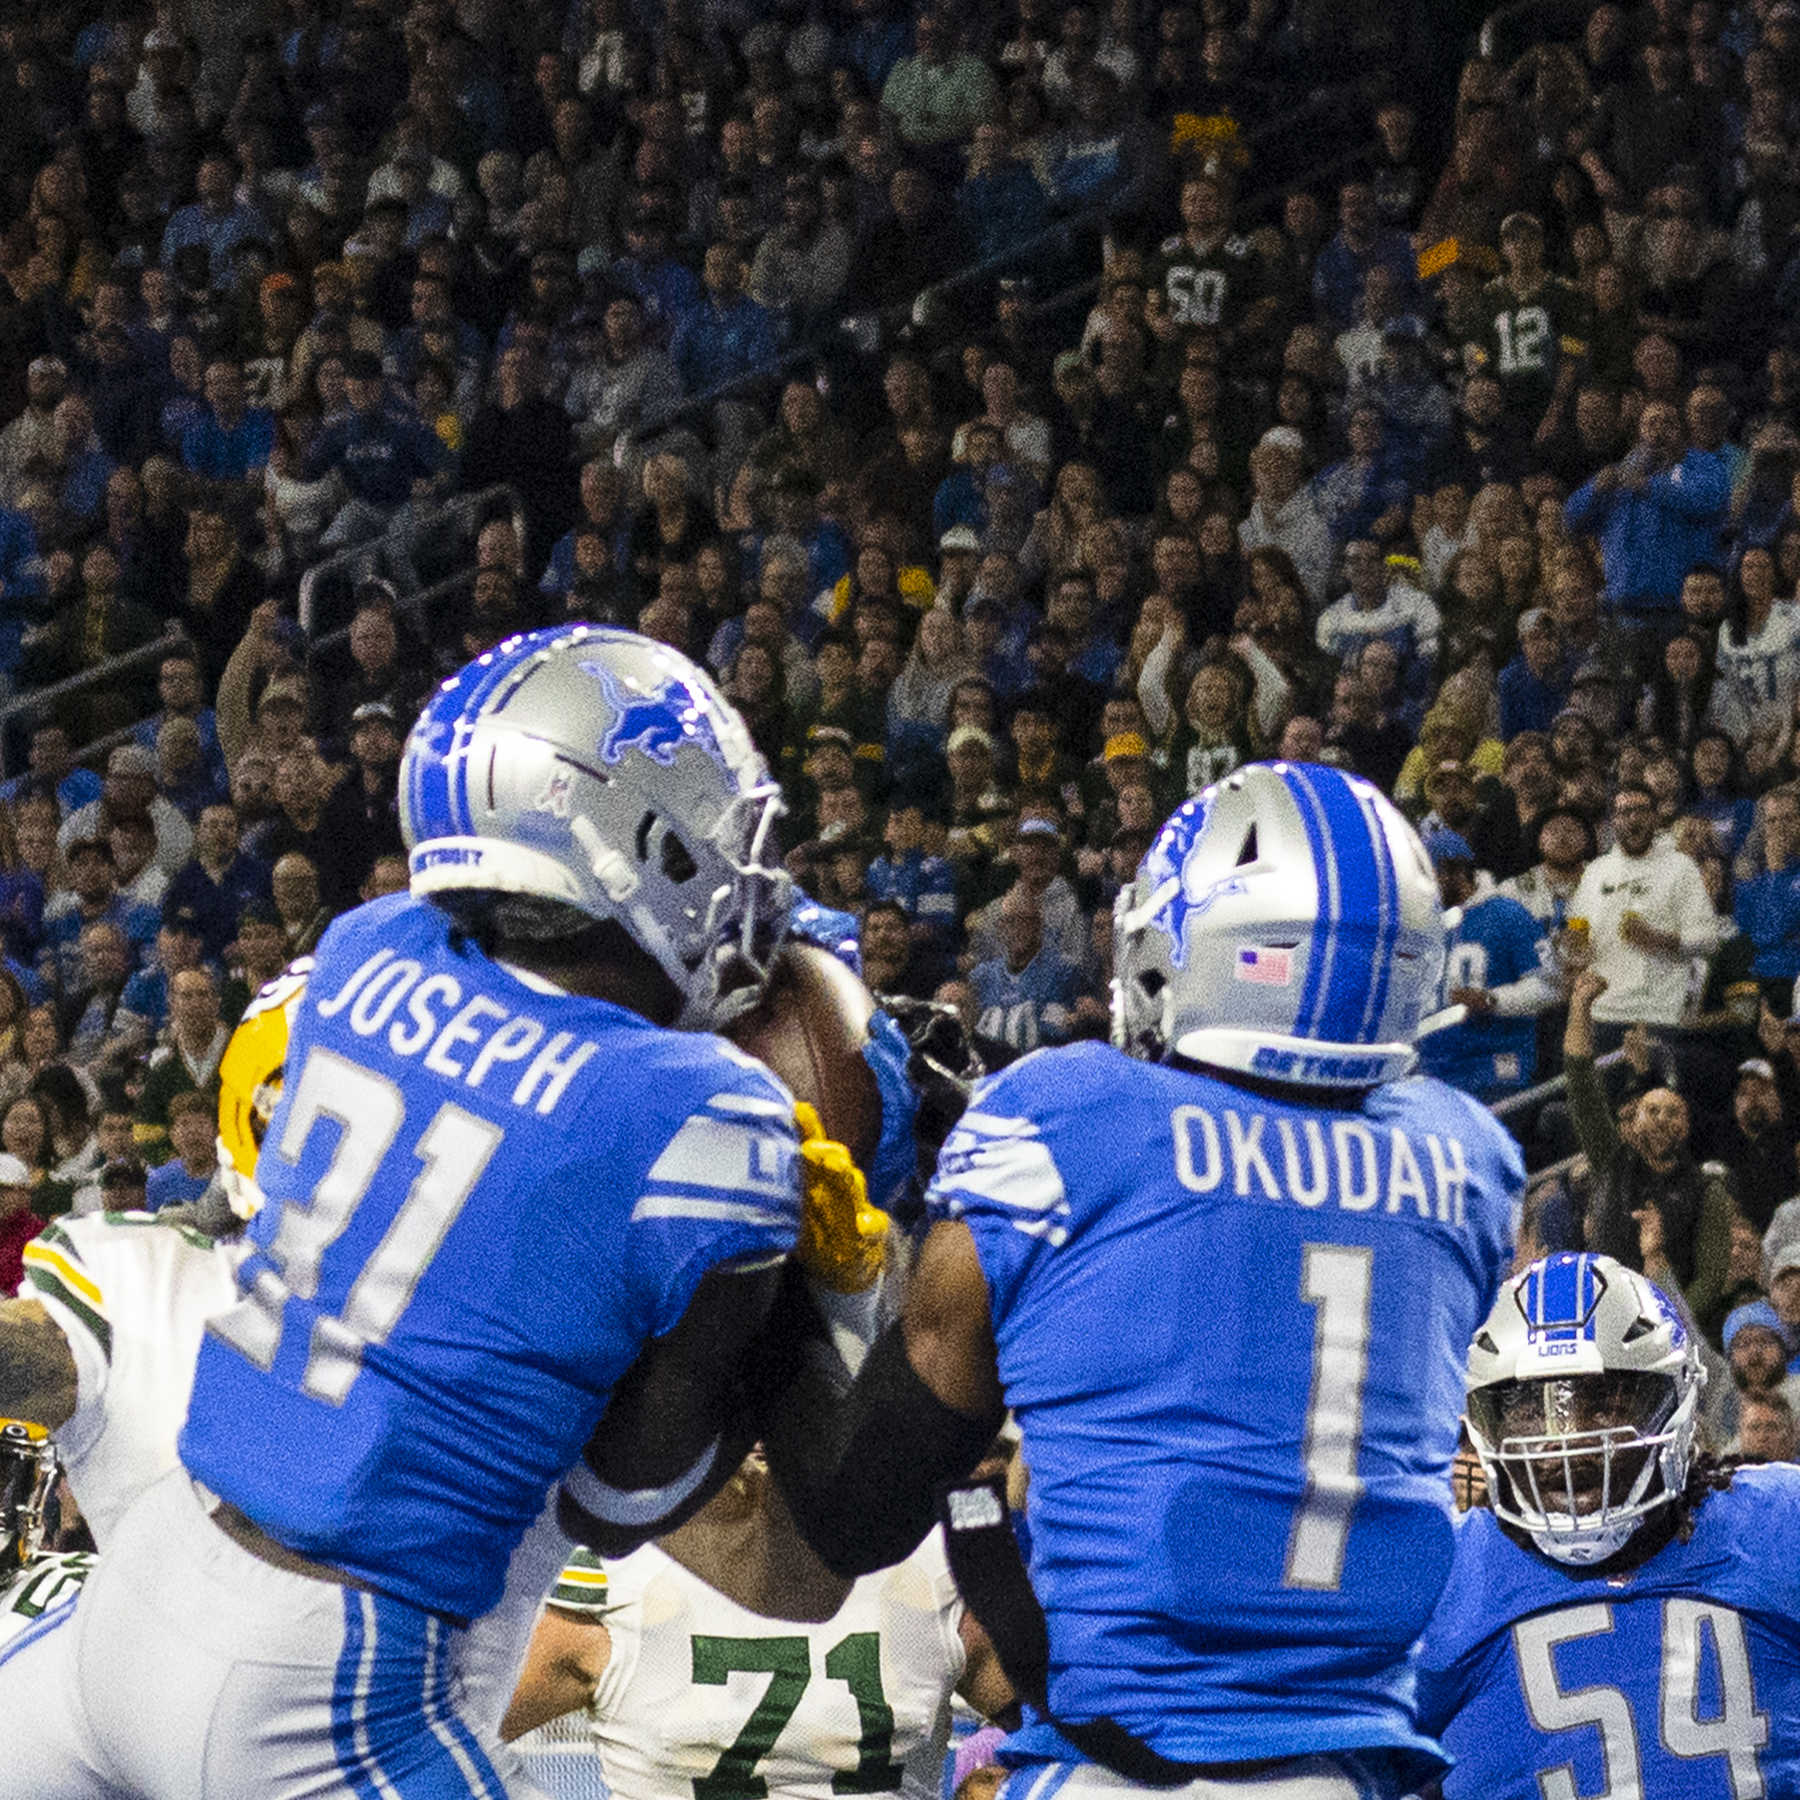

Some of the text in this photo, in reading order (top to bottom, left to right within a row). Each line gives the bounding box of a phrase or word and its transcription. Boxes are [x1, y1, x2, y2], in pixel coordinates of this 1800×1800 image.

[1166, 265, 1226, 325] 50
[1494, 306, 1550, 372] 12
[318, 947, 603, 1114] JOSEPH
[1250, 1046, 1385, 1081] DETROIT
[1174, 1103, 1468, 1225] OKUDAH
[203, 1045, 504, 1409] 31
[1538, 1342, 1578, 1358] LIONS
[1282, 1244, 1372, 1590] 1
